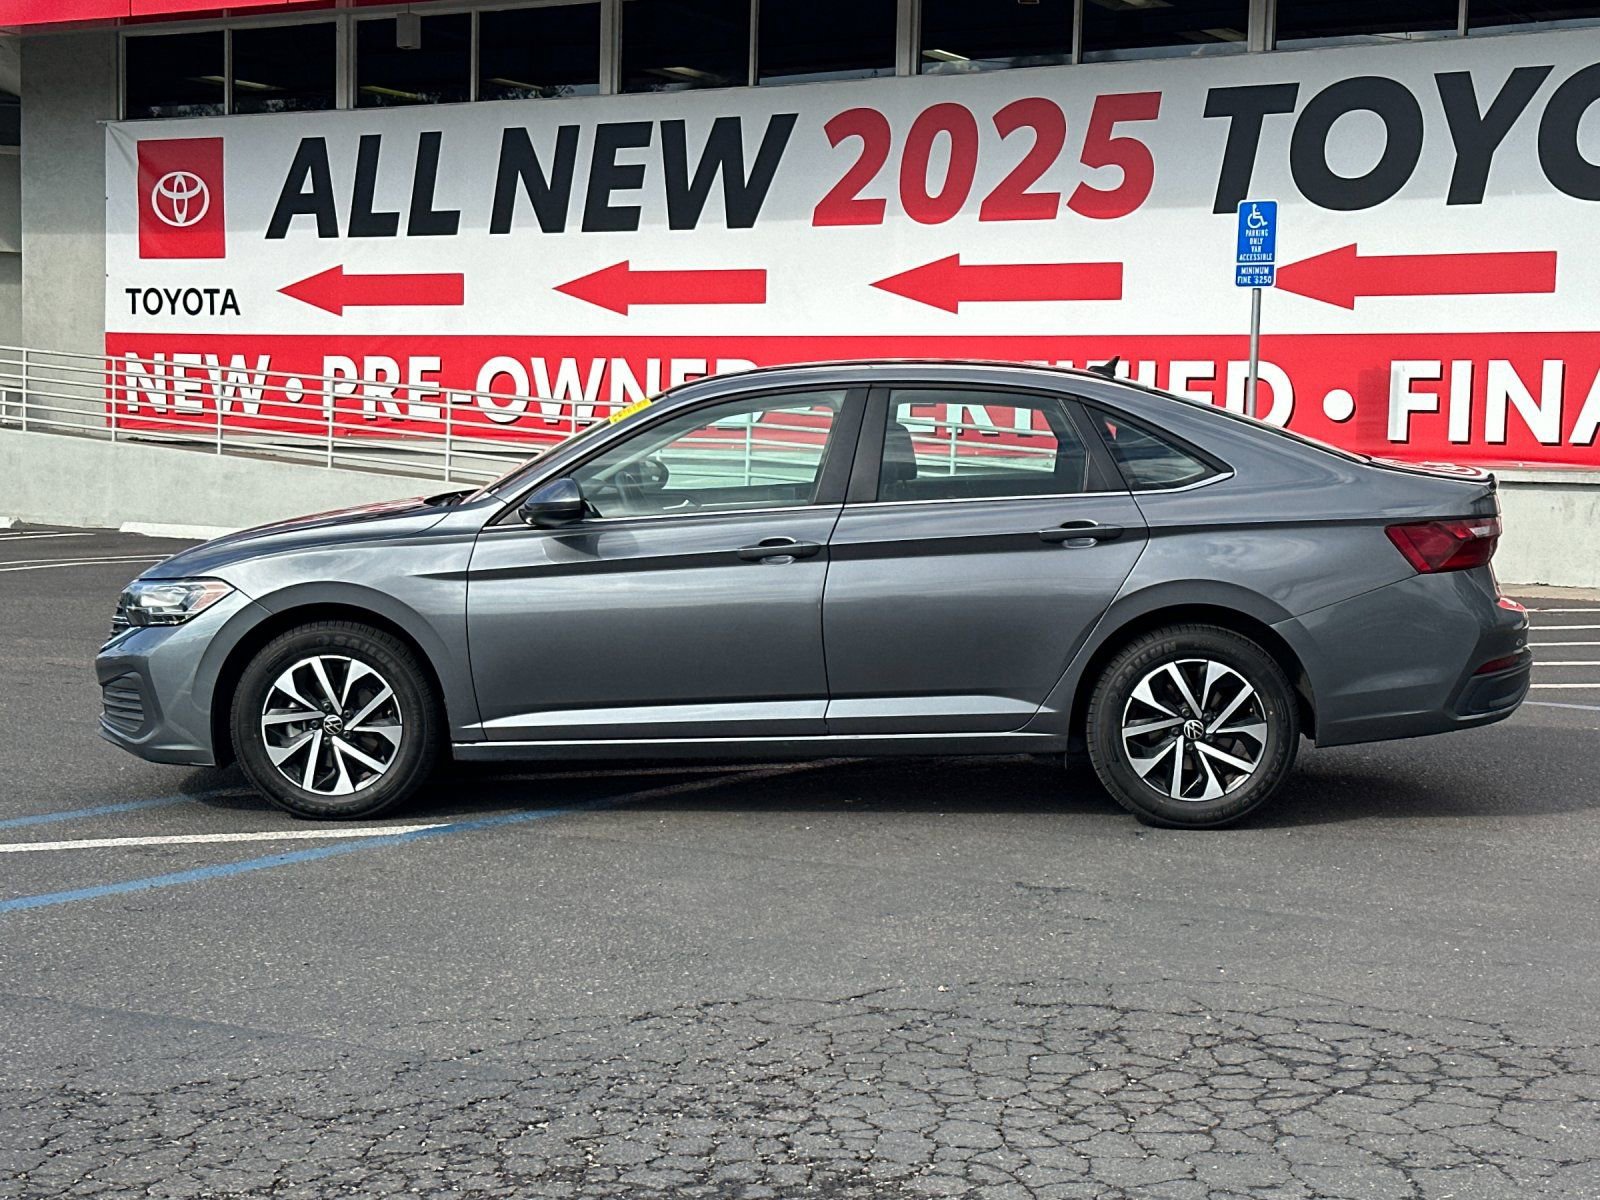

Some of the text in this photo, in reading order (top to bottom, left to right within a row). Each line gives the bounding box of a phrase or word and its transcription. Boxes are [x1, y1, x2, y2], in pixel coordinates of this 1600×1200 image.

[264, 131, 461, 239] ALL
[489, 113, 799, 234] NEW
[812, 91, 1163, 227] 2025
[1245, 229, 1269, 237] PARKING
[1239, 253, 1273, 261] ACCESSIBLE
[1241, 266, 1269, 275] MINIMUM
[1237, 275, 1272, 284] FINE $250
[125, 287, 241, 316] TOYOTA
[125, 352, 271, 417] NEW
